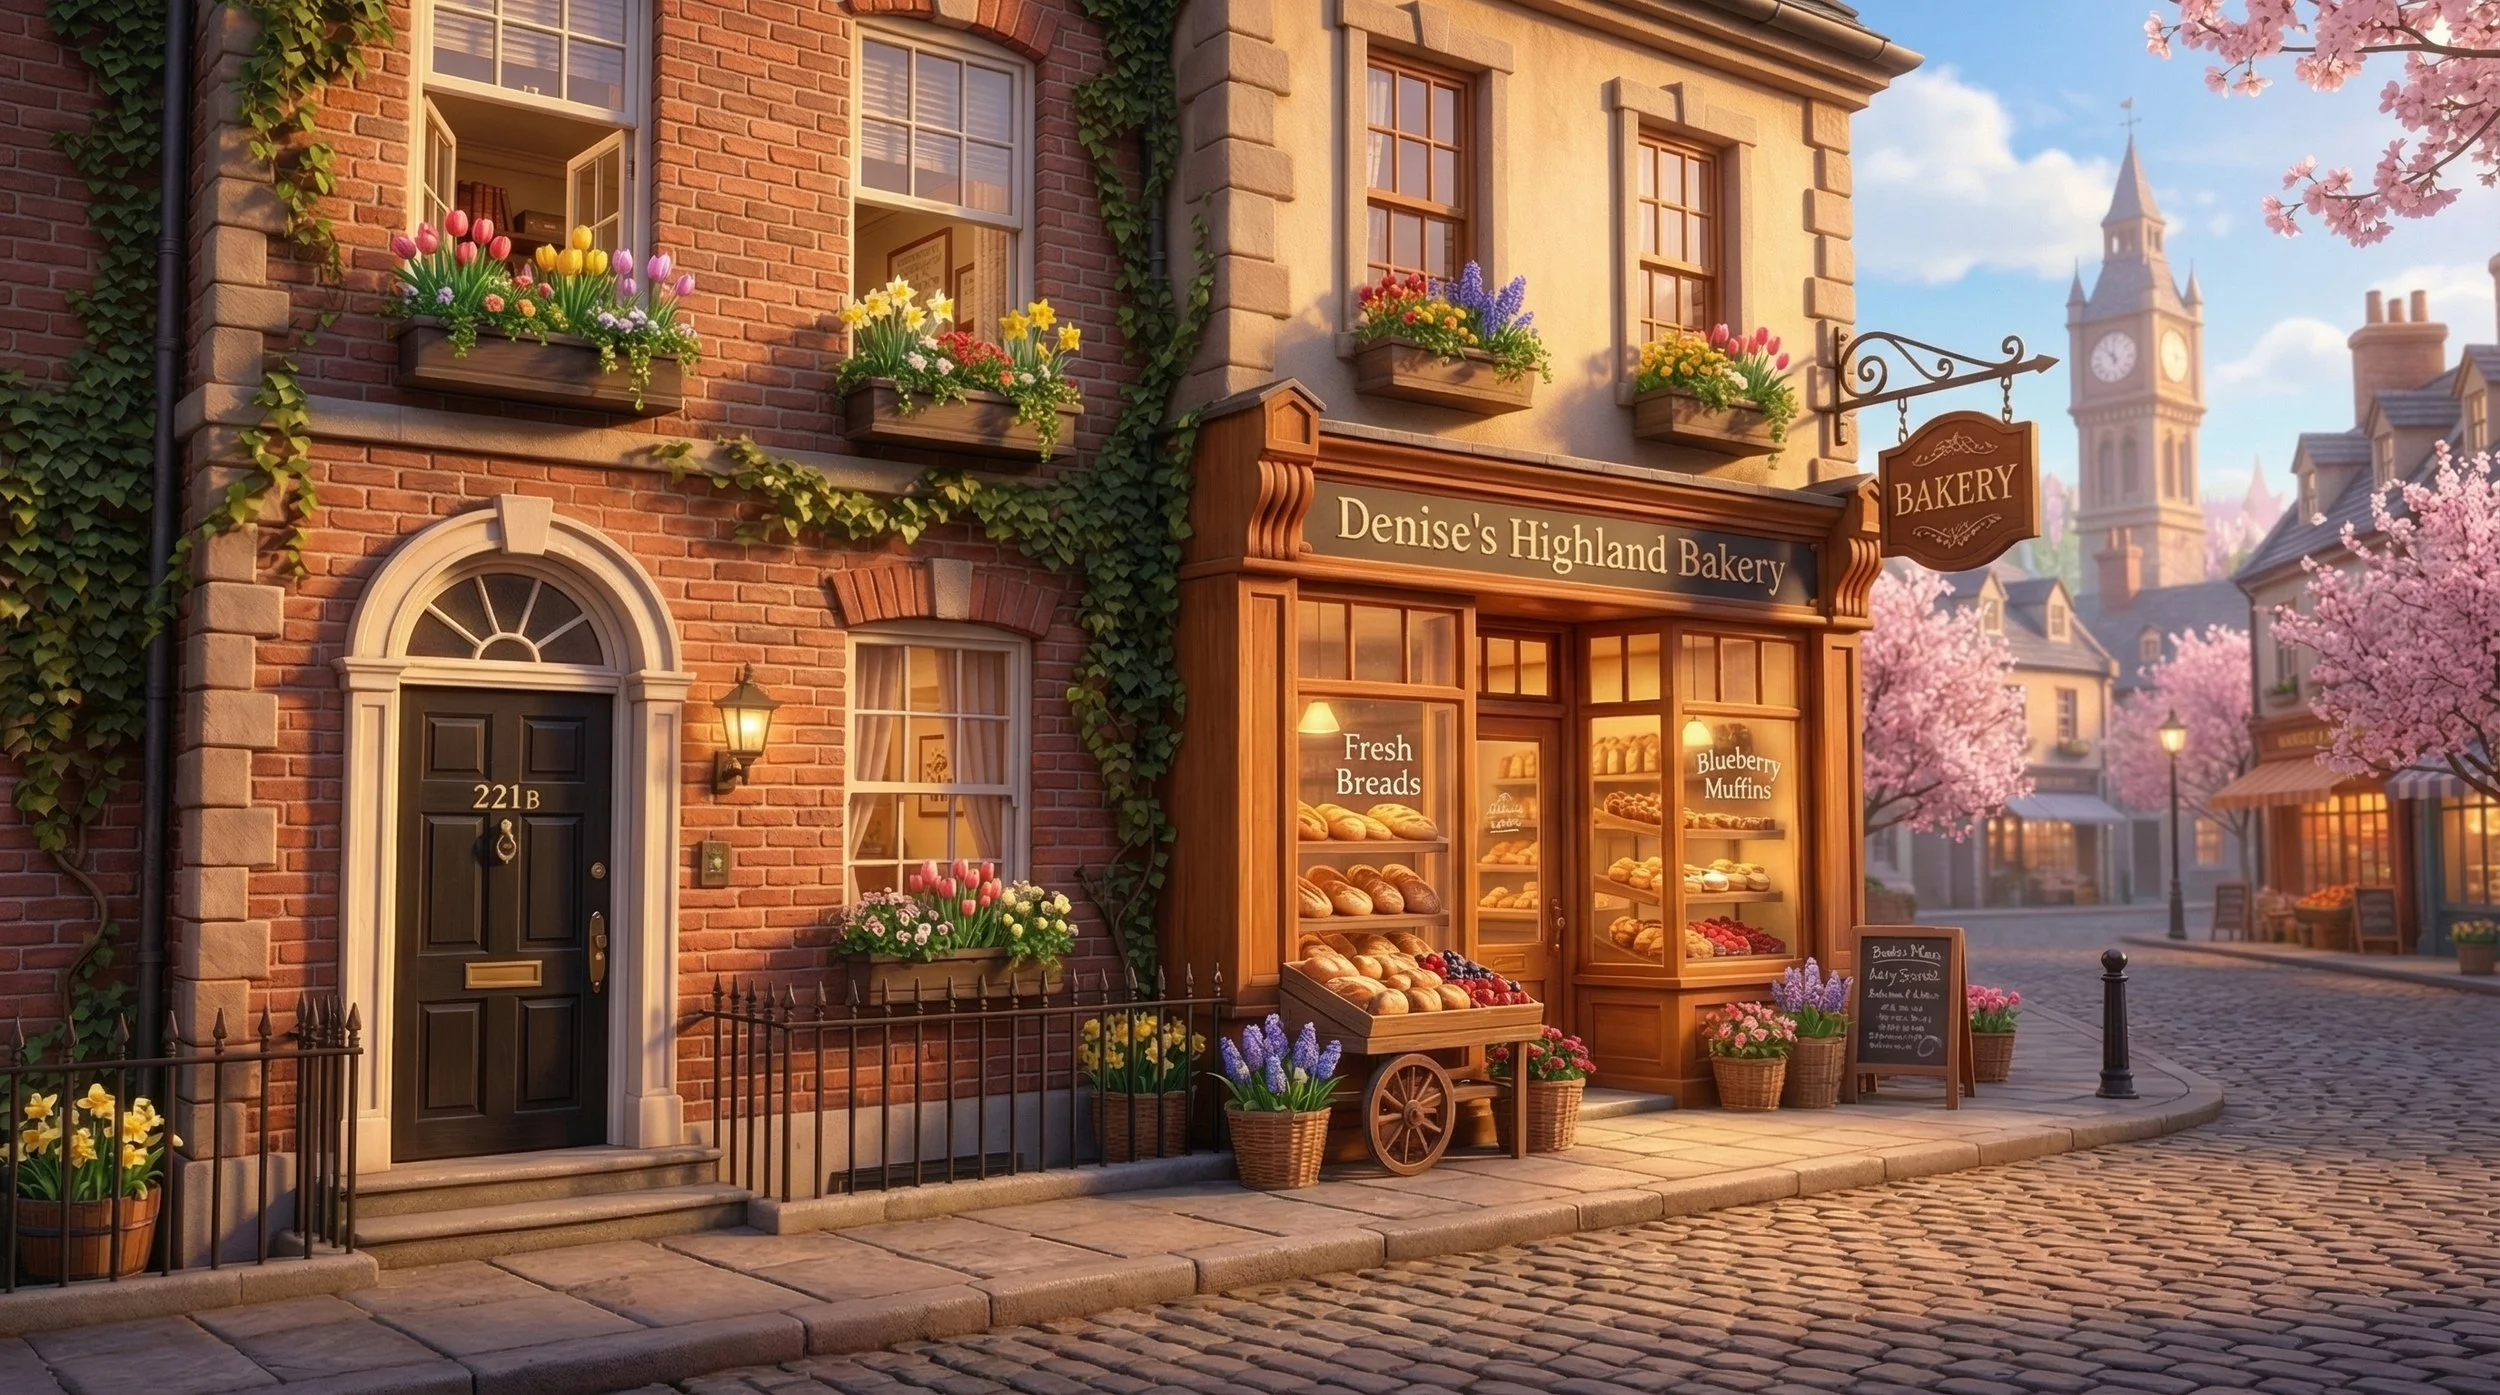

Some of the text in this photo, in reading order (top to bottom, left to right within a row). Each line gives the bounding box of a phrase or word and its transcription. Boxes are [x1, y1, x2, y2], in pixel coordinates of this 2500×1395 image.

[1894, 463, 2018, 517] BAKERY
[1337, 496, 1787, 597] Denise's Highland Bakery
[1343, 733, 1414, 762] Fresh
[1696, 746, 1782, 782] Blueberry
[1336, 768, 1421, 796] Breads
[1704, 776, 1772, 800] Muffins
